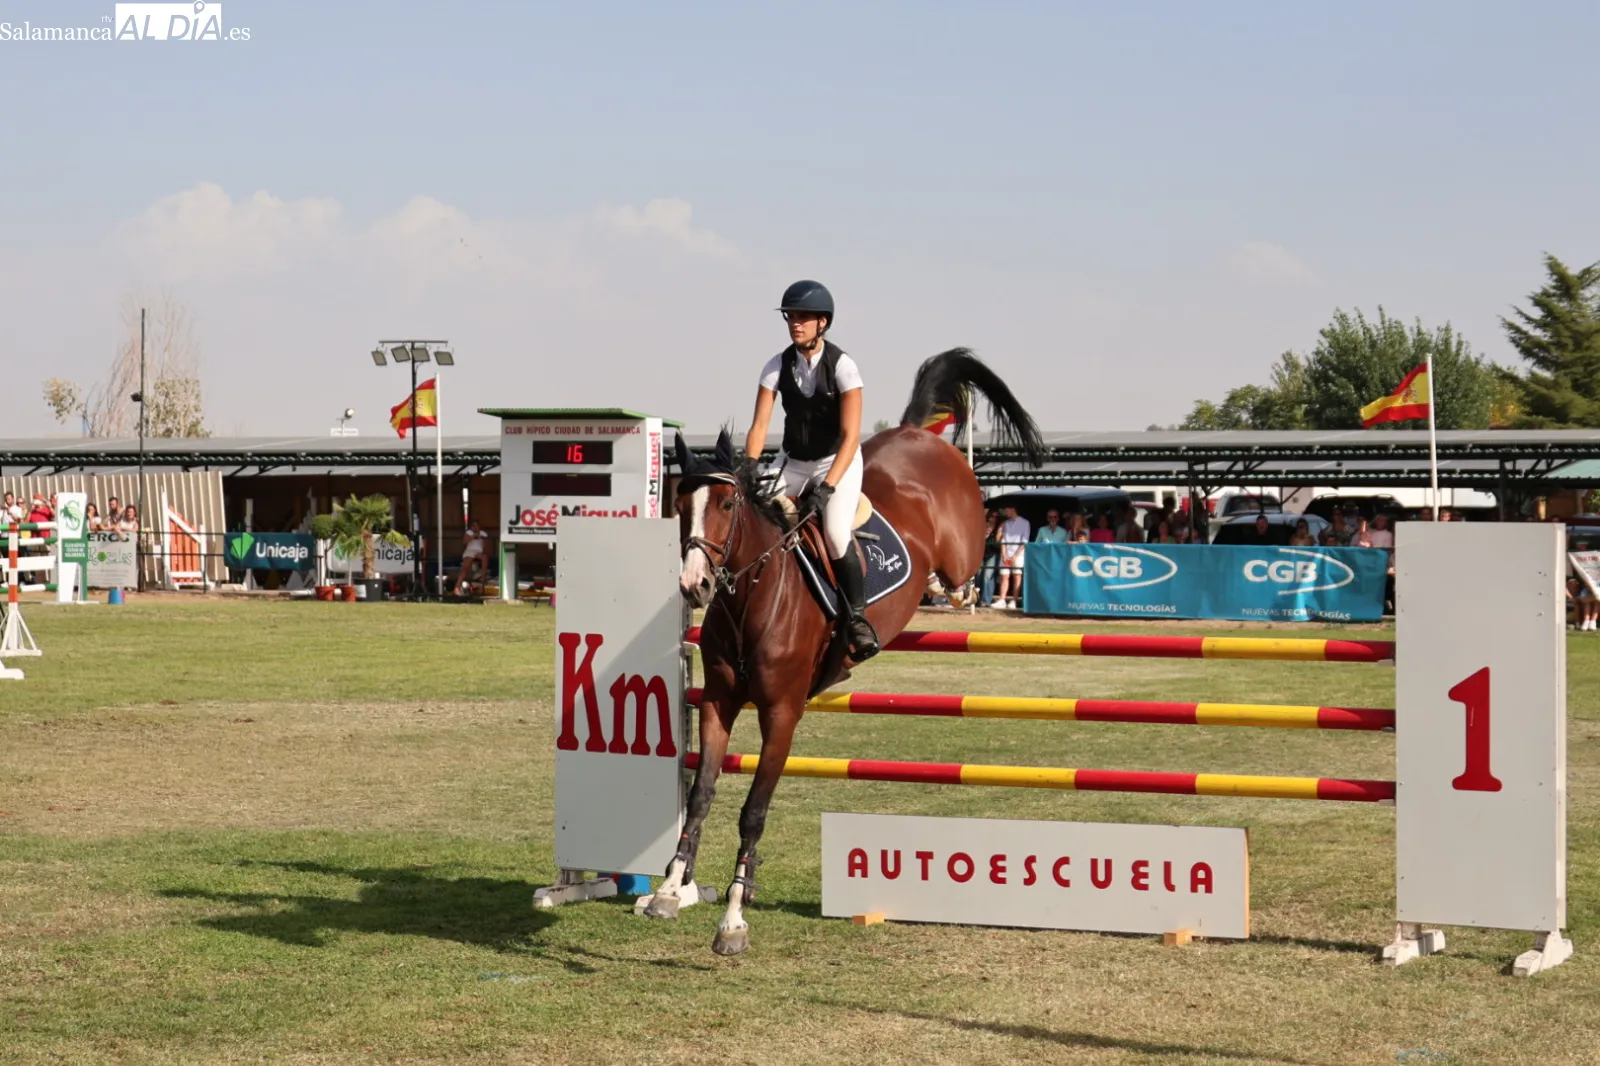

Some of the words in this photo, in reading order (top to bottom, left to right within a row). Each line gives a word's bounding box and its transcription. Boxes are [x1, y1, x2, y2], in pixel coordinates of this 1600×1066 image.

[505, 426, 523, 435] CLUB
[554, 426, 581, 435] CIUDAD
[584, 426, 594, 435] DE
[598, 426, 641, 435] SALAMANCA
[567, 444, 583, 463] 16
[508, 503, 559, 526] José
[255, 542, 309, 563] Unicaja
[375, 545, 415, 565] nicaja
[1070, 555, 1143, 578] CGB
[1243, 559, 1318, 583] CGB
[1068, 602, 1105, 611] NUEVAS
[1107, 602, 1177, 613] TECNOLOGÍAS
[1242, 607, 1279, 617] NUEVAS
[556, 632, 678, 758] Km
[1448, 666, 1503, 792] 1
[847, 847, 1214, 894] AUTOESCUELA
